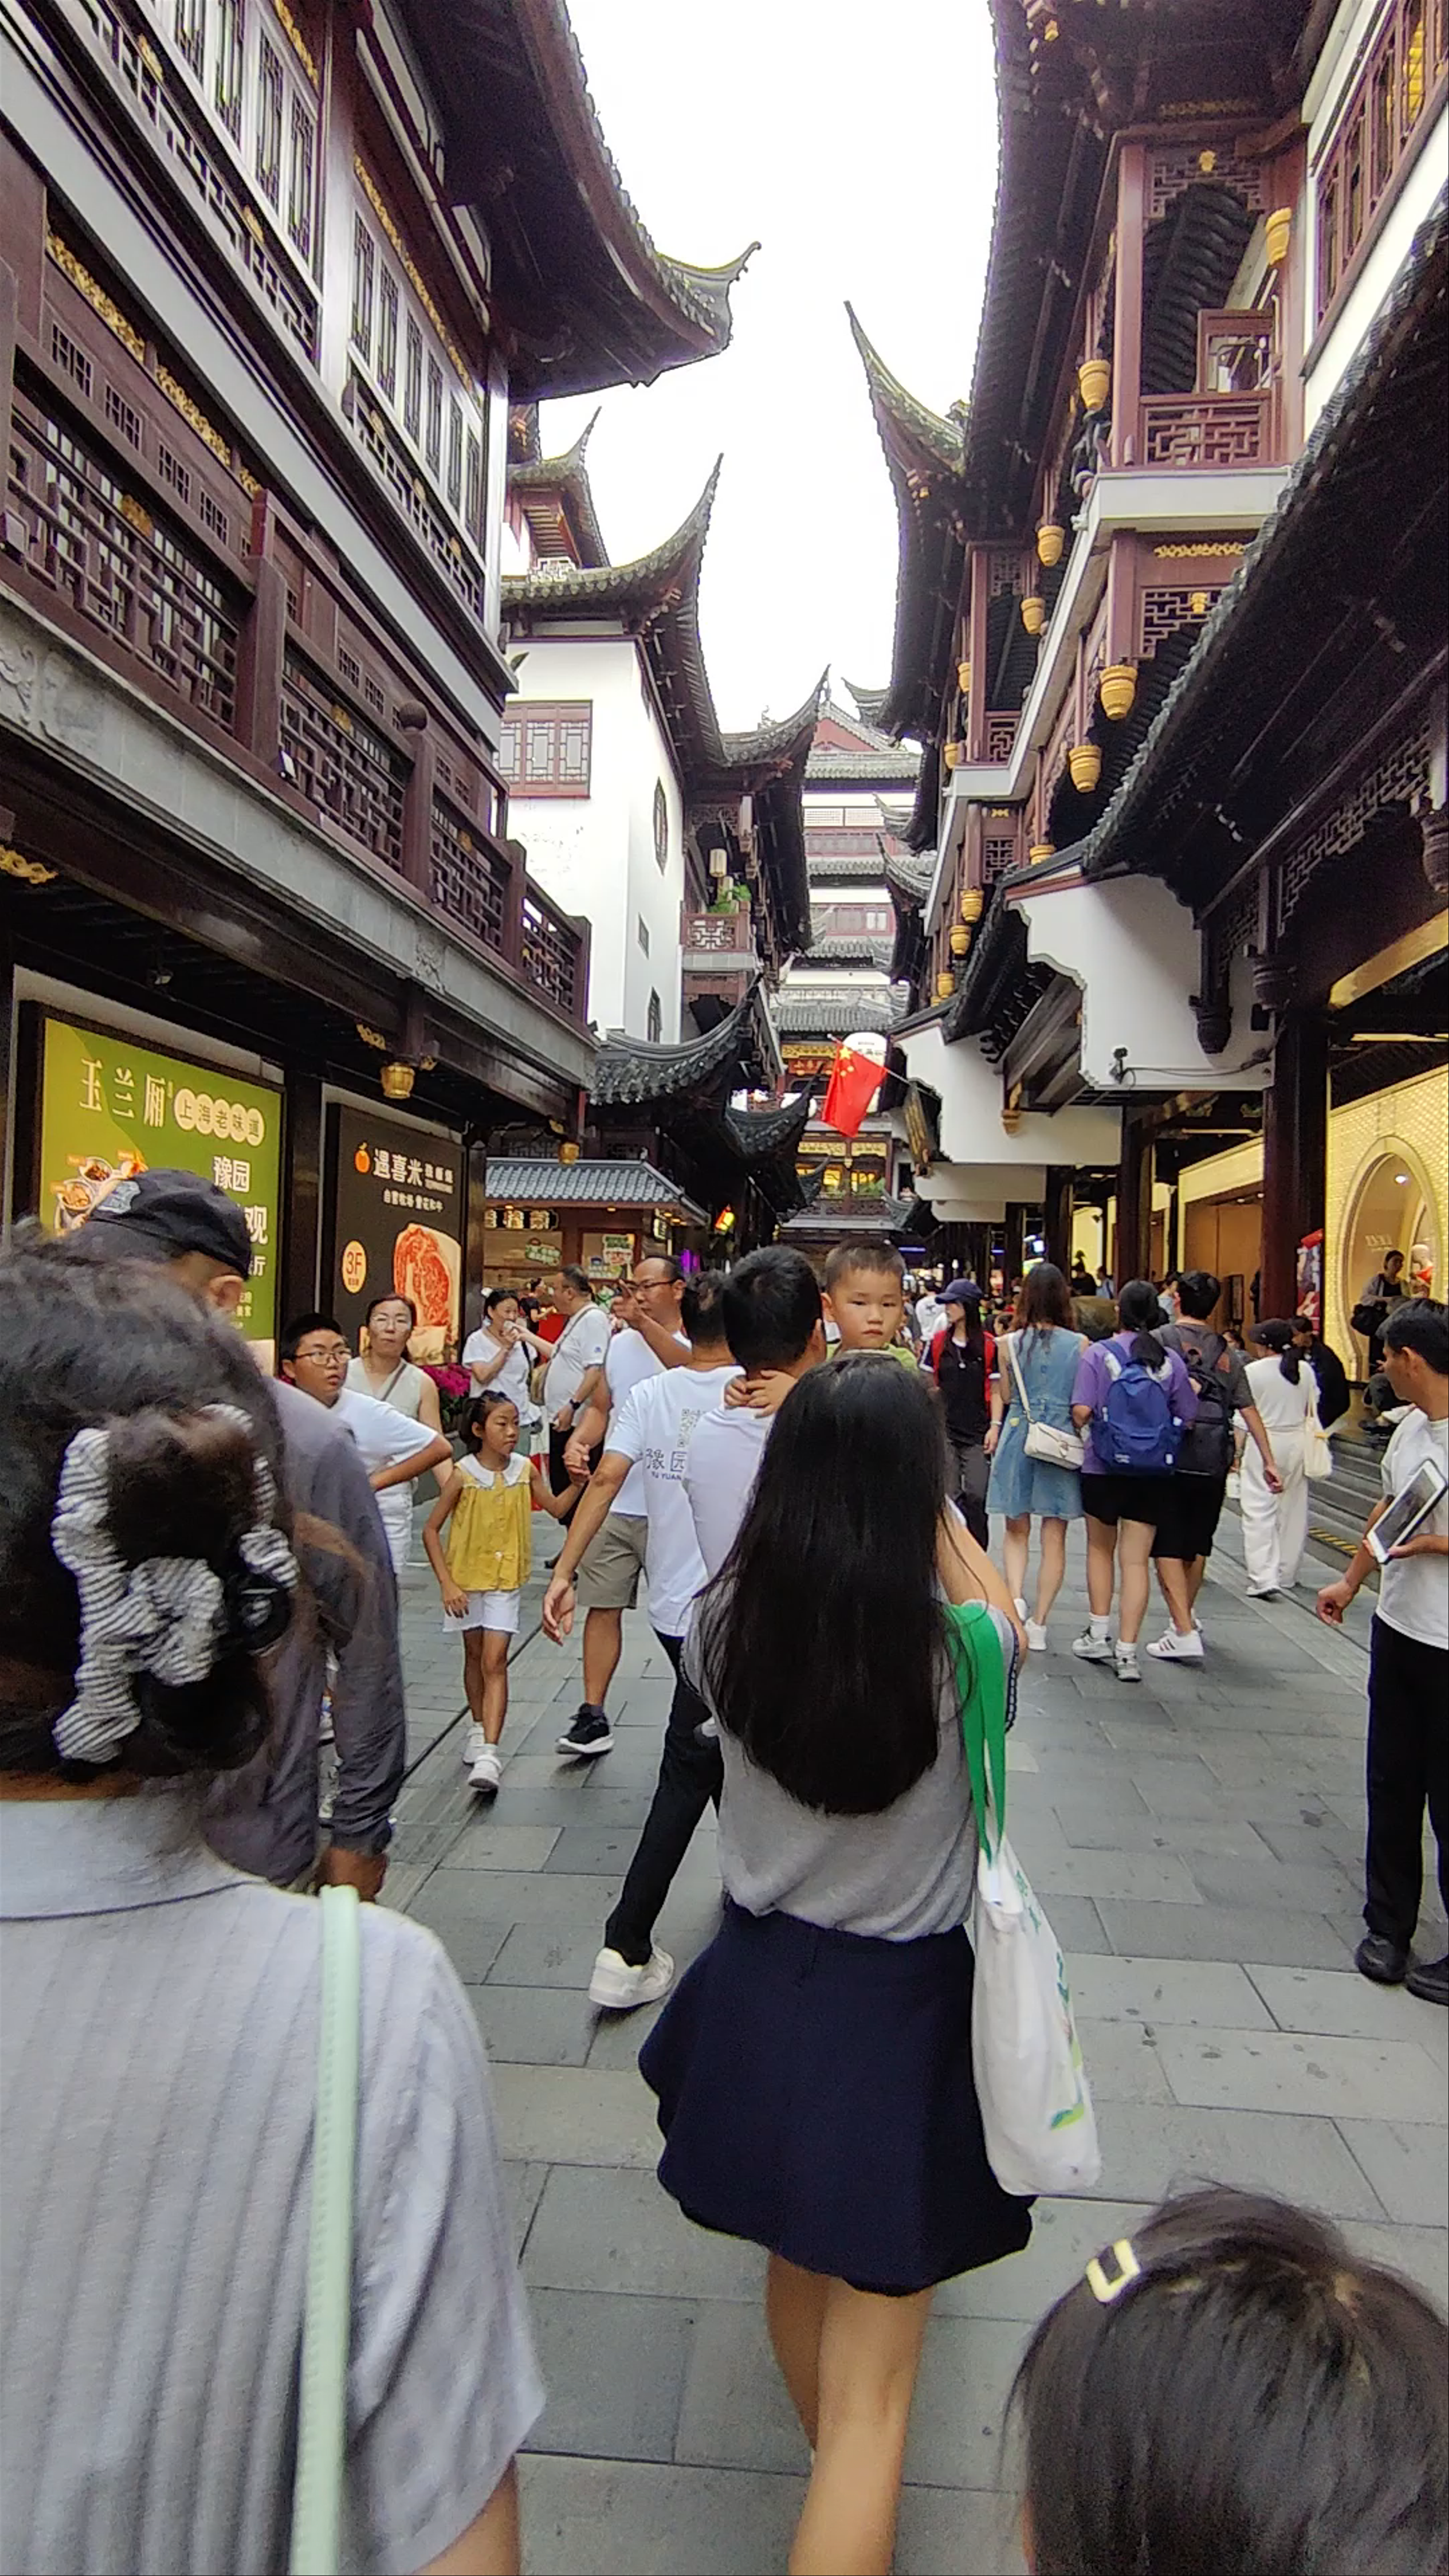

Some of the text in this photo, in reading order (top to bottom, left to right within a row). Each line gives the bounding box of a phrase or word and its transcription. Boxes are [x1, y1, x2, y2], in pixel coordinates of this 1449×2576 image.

[180, 1099, 259, 1138] 上海老味道
[213, 1156, 250, 1193] 豫园
[346, 1251, 362, 1275] 3F
